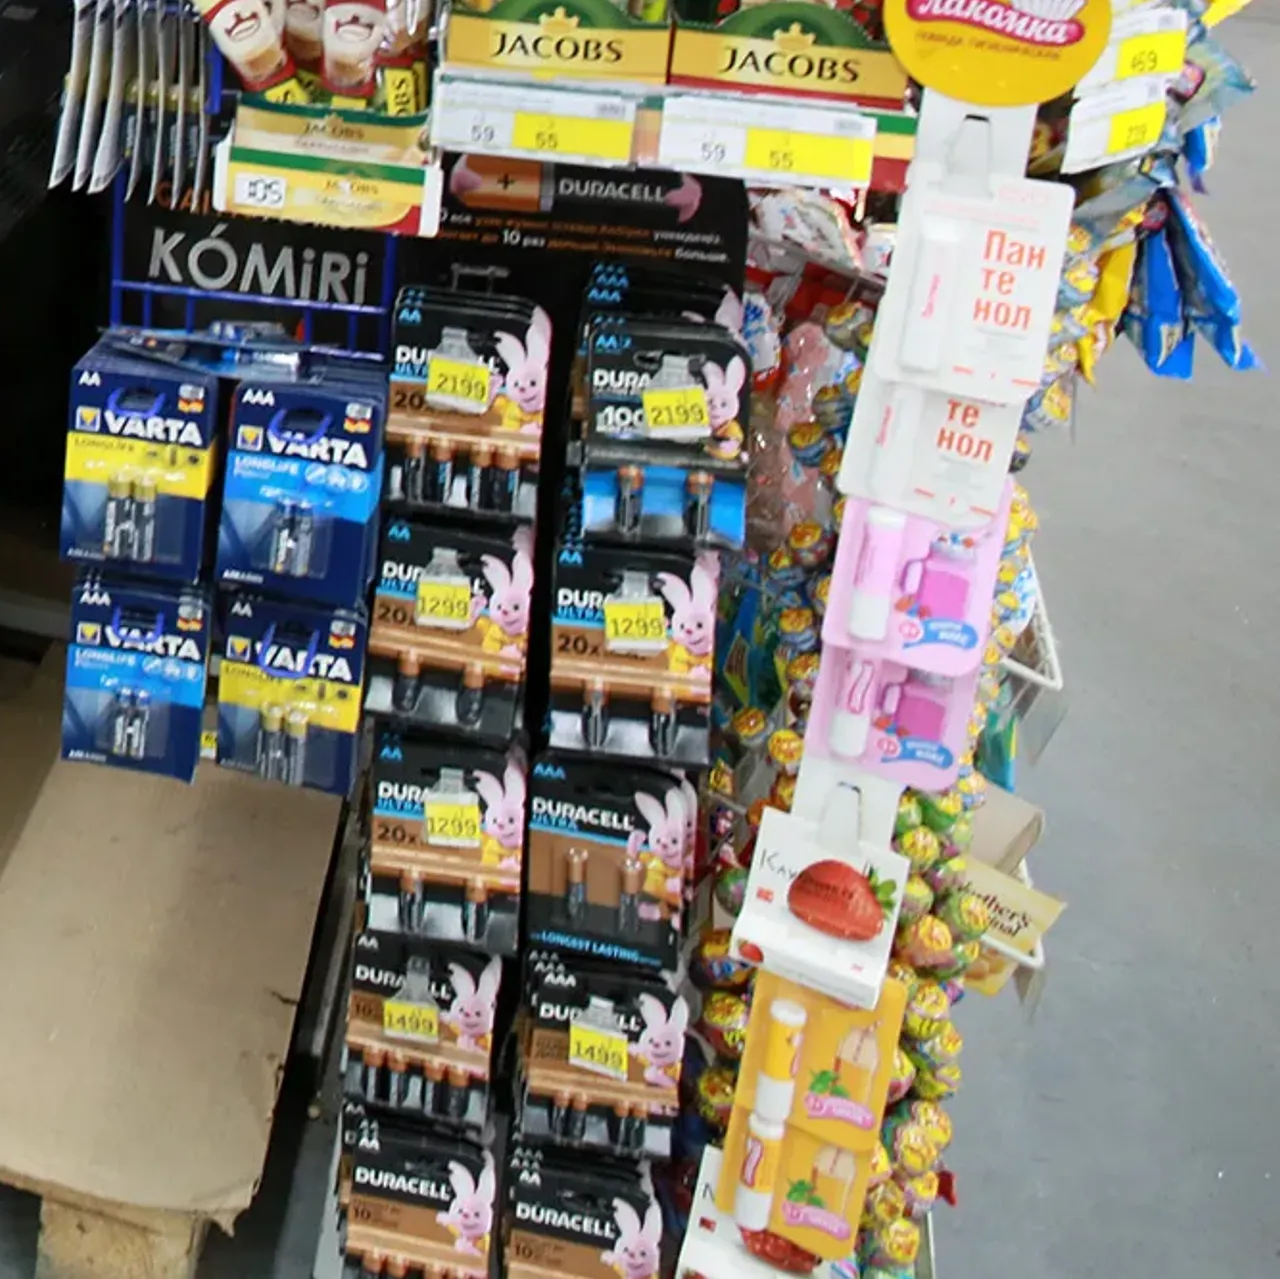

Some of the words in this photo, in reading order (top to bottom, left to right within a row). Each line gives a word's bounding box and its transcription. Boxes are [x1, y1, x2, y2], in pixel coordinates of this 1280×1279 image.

[491, 32, 625, 64] JACOBS
[717, 49, 861, 84] JACOBS
[470, 125, 495, 143] 59
[534, 131, 560, 151] 55
[701, 142, 726, 161] 59
[768, 150, 795, 170] 55
[557, 176, 667, 204] DURACELL
[502, 230, 521, 246] 10
[981, 228, 1047, 272] Пан
[981, 269, 1016, 297] те
[587, 288, 622, 304] AAA
[399, 307, 422, 324] AA
[973, 299, 1033, 332] нол
[79, 371, 101, 387] AA
[436, 372, 486, 402] 2199
[592, 368, 653, 391] DURA
[242, 388, 275, 407] AAA
[650, 402, 705, 426] 2199
[104, 410, 203, 446] VARTA
[267, 430, 368, 469] VARTA
[935, 428, 994, 464] нол
[387, 524, 411, 542] AA
[559, 550, 584, 566] AA
[79, 590, 111, 606] AAA
[231, 601, 253, 618] AA
[418, 595, 469, 620] 1299
[609, 615, 664, 637] 1299
[104, 624, 201, 661] VARTA
[254, 640, 353, 682] VARTA
[380, 745, 403, 761] AA
[533, 762, 567, 780] AAA
[531, 795, 635, 832] DURACELL
[426, 816, 478, 838] 1299
[357, 935, 379, 950] AA
[544, 972, 577, 989] AAA
[385, 1010, 435, 1034] 1499
[574, 1039, 623, 1068] 1499
[358, 1136, 381, 1151] AA
[354, 1164, 452, 1202] DURACELL
[519, 1169, 542, 1186] AA
[515, 1201, 617, 1239] DURACELL
